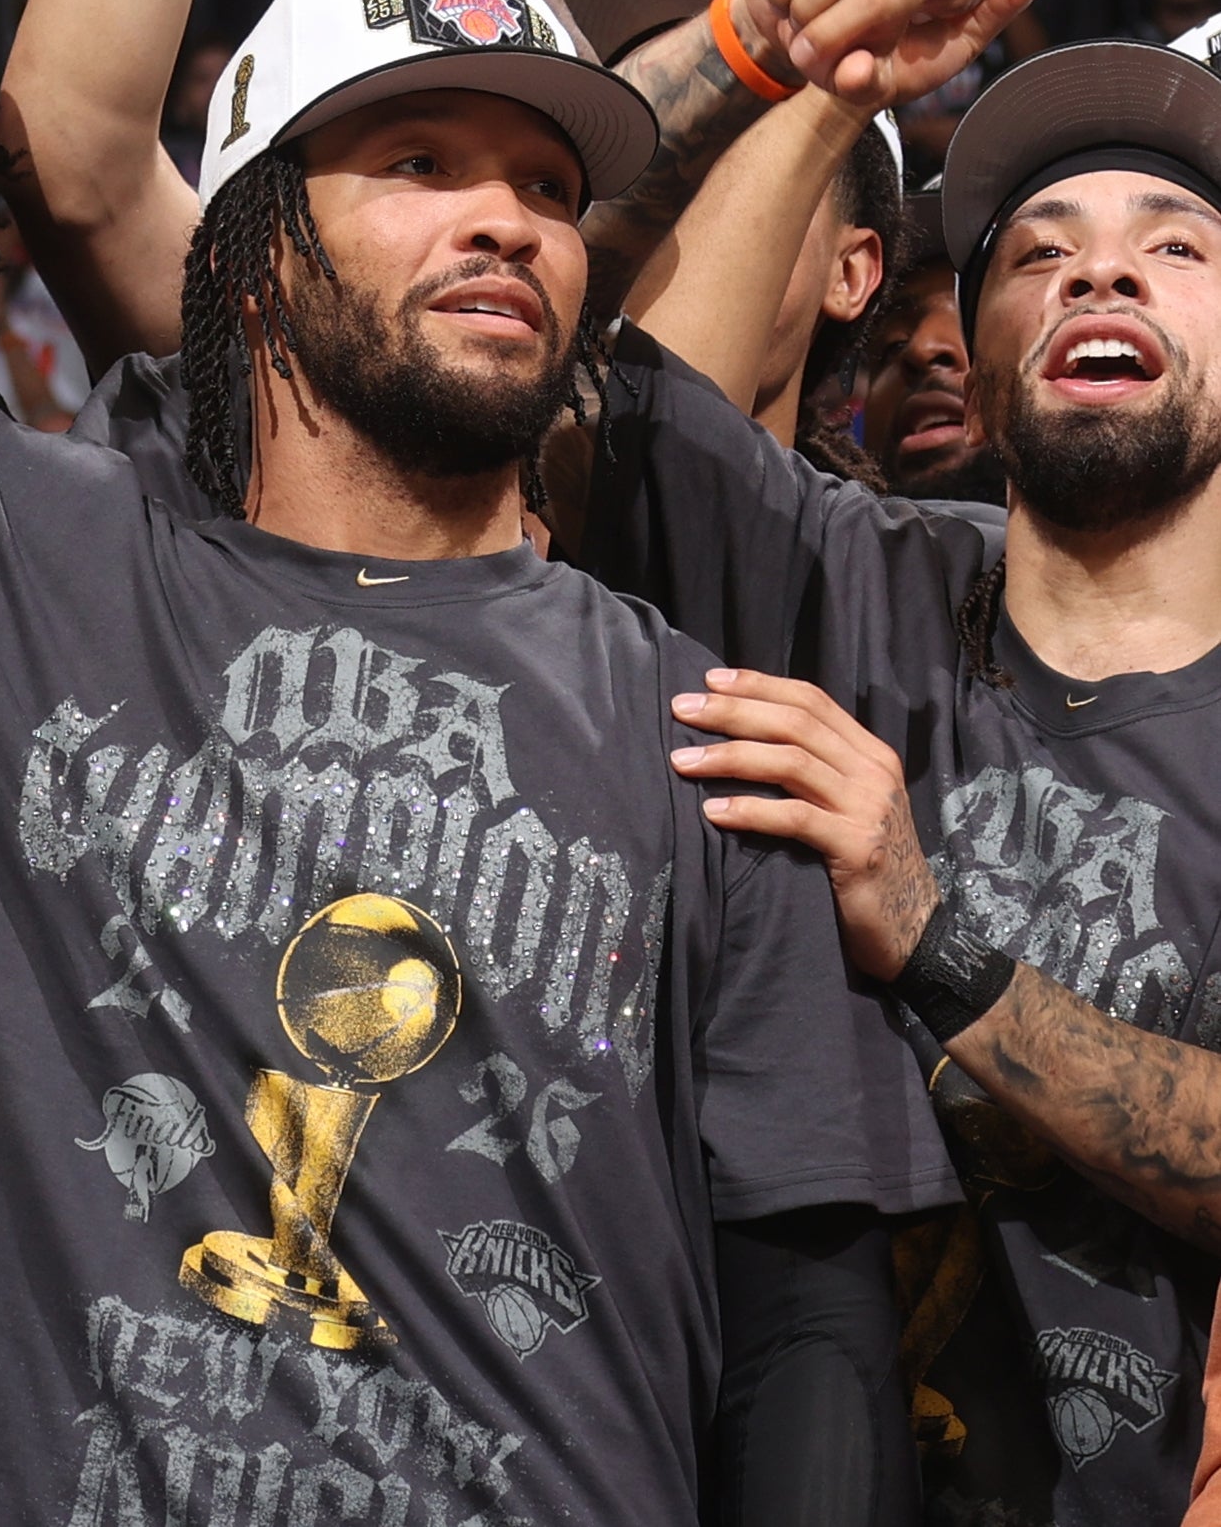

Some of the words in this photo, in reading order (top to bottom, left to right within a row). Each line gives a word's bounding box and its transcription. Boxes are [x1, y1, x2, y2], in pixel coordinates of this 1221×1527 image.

[368, 3, 391, 23] 25
[221, 624, 515, 808] NBA
[77, 1087, 215, 1152] Finals
[490, 1223, 516, 1237] NEW
[450, 1228, 583, 1317] KNICKS
[1036, 1334, 1160, 1416] KNICKS
